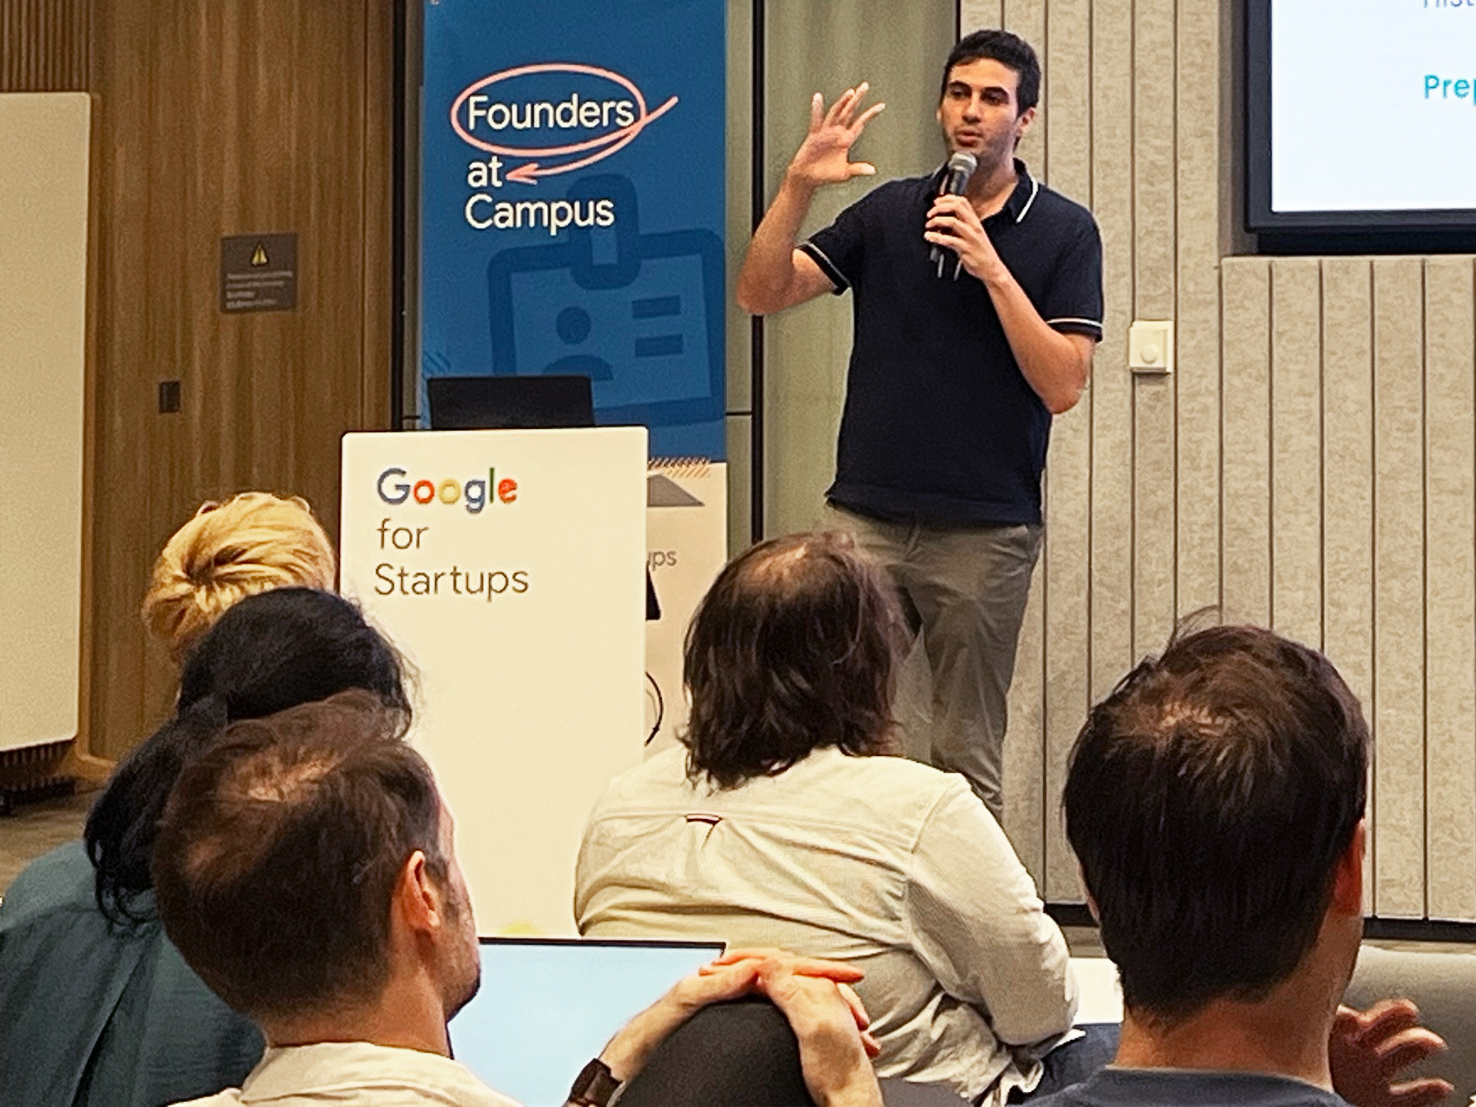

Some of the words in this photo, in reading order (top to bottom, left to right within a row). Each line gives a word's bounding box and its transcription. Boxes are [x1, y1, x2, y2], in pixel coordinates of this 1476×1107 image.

[466, 95, 635, 131] Founders
[467, 155, 503, 188] at
[465, 194, 614, 235] Campus
[377, 467, 518, 514] Google
[377, 518, 429, 550] for
[374, 562, 529, 602] Startups
